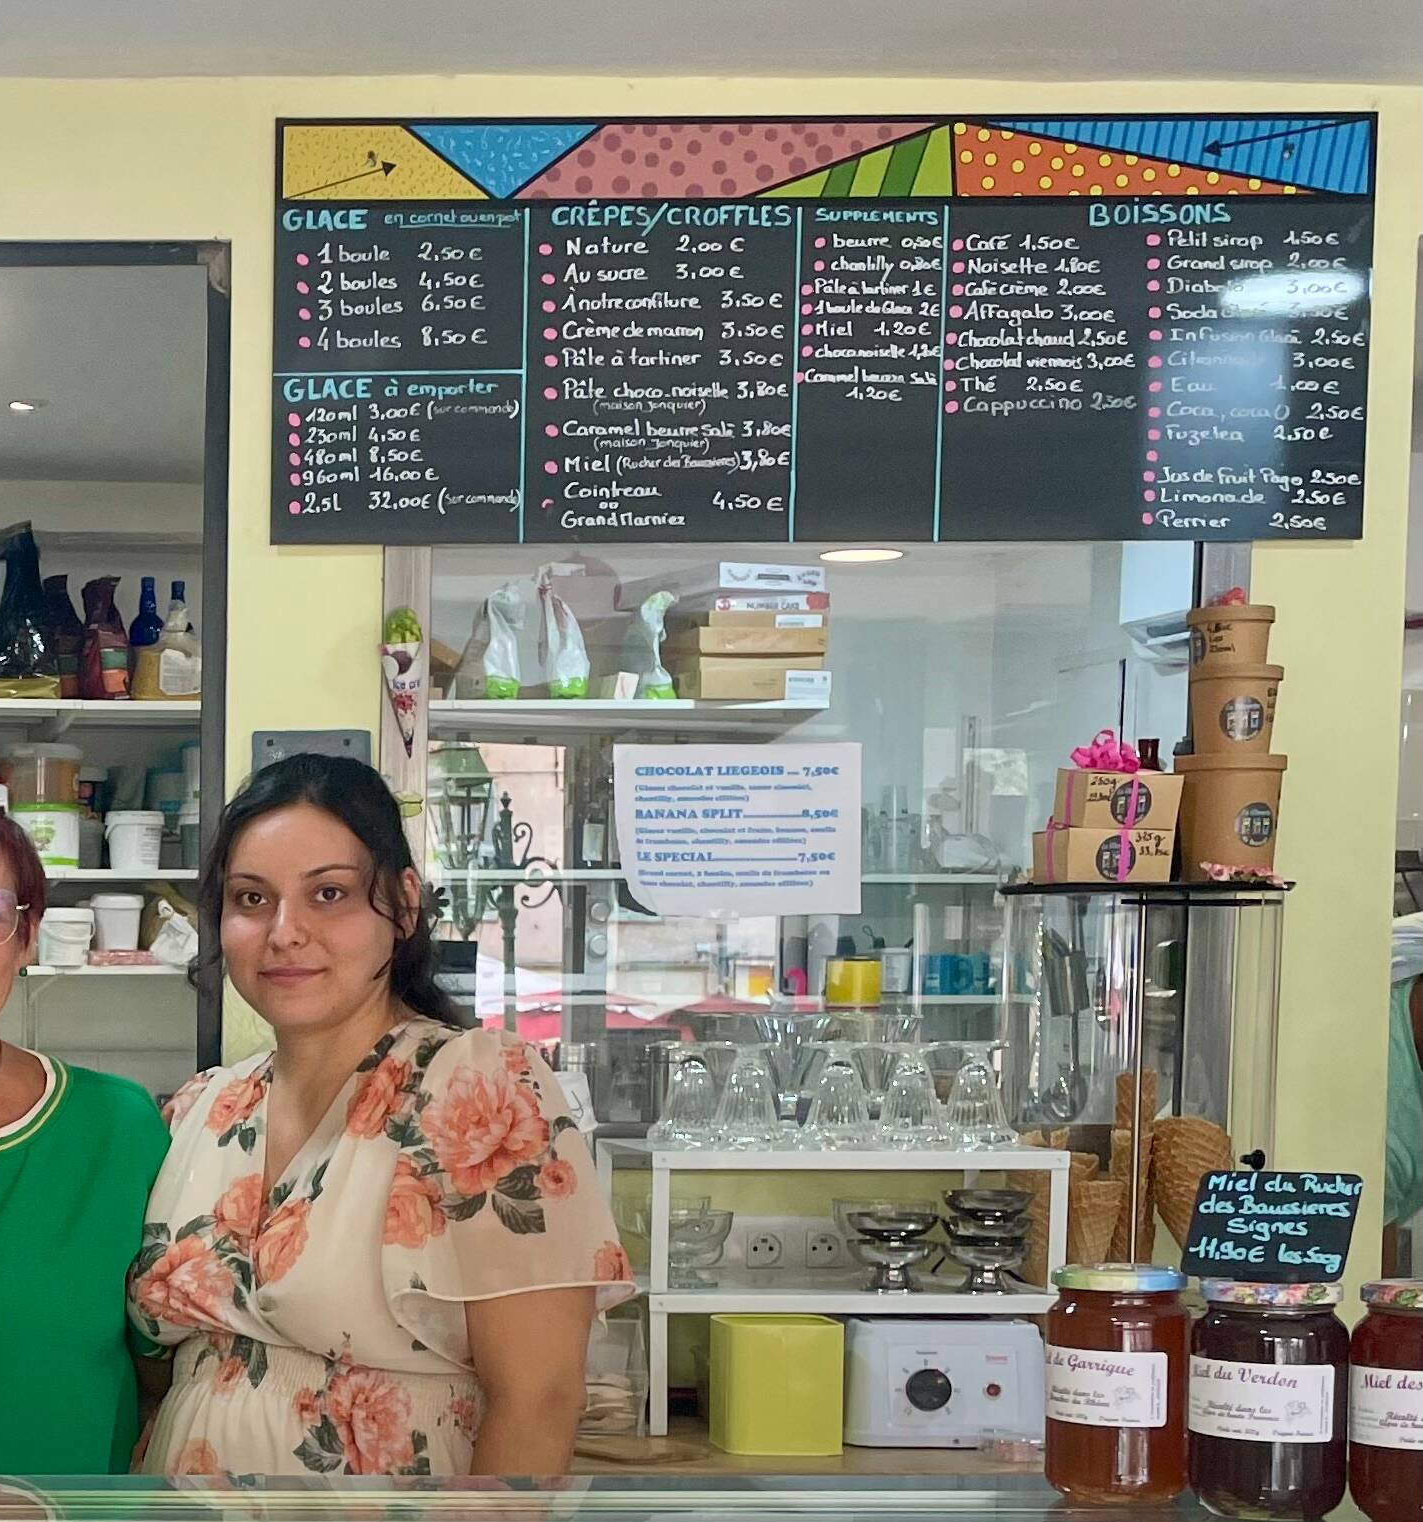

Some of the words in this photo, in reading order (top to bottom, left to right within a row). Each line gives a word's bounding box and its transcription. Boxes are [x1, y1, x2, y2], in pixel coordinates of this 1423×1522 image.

[282, 209, 368, 232] GLACE
[815, 208, 938, 225] SUPPLEMENTS
[1089, 197, 1231, 227] BOISSONS
[566, 237, 649, 255] Nature
[833, 233, 892, 248] beurre
[966, 234, 1012, 251] Café
[1167, 229, 1206, 247] Petit
[1213, 233, 1263, 250] sirop
[317, 243, 333, 263] 1
[339, 245, 390, 262] boule
[564, 263, 590, 284] Au
[597, 267, 648, 281] sucre
[968, 257, 1048, 274] Noisette
[1167, 255, 1224, 270] Grand
[1230, 259, 1273, 273] sirop
[318, 271, 333, 294] 2
[340, 272, 397, 290] boules
[318, 300, 332, 321] 3
[341, 297, 403, 315] boules
[562, 318, 620, 339] Crème
[623, 321, 644, 337] de
[816, 321, 852, 336] Miel
[958, 328, 1026, 347] Chocolat
[1026, 328, 1075, 347] chaud
[317, 327, 328, 350] 4
[337, 330, 401, 349] boules
[562, 347, 605, 367] Pâte
[612, 351, 624, 366] à
[629, 349, 701, 366] tartiner
[283, 378, 372, 403] GLACE
[385, 379, 398, 397] à
[407, 379, 498, 399] emporter
[960, 376, 996, 392] Thé
[1171, 377, 1217, 392] Eau
[306, 405, 357, 422] 120ml
[964, 395, 1082, 416] Cappuccino
[563, 418, 639, 437] Caramel
[646, 421, 699, 437] beurre
[303, 448, 357, 466] 480ml
[302, 466, 359, 486] 960ml
[564, 481, 662, 499] Cointreau
[1161, 488, 1266, 504] Limonade
[1156, 509, 1230, 528] Perrier
[635, 766, 713, 776] CHOCOLAT
[717, 766, 784, 776] LIEGEOIS
[635, 809, 698, 819] BANANA
[637, 852, 651, 862] LE
[1208, 1173, 1258, 1191] Miel
[1265, 1174, 1296, 1192] du
[1199, 1194, 1235, 1214] des
[1227, 1218, 1308, 1242] Signes
[1068, 1354, 1134, 1377] Garrigue
[1214, 1366, 1232, 1380] du
[1238, 1368, 1297, 1388] Verdon
[1361, 1374, 1392, 1388] Miel
[1397, 1375, 1423, 1390] des
